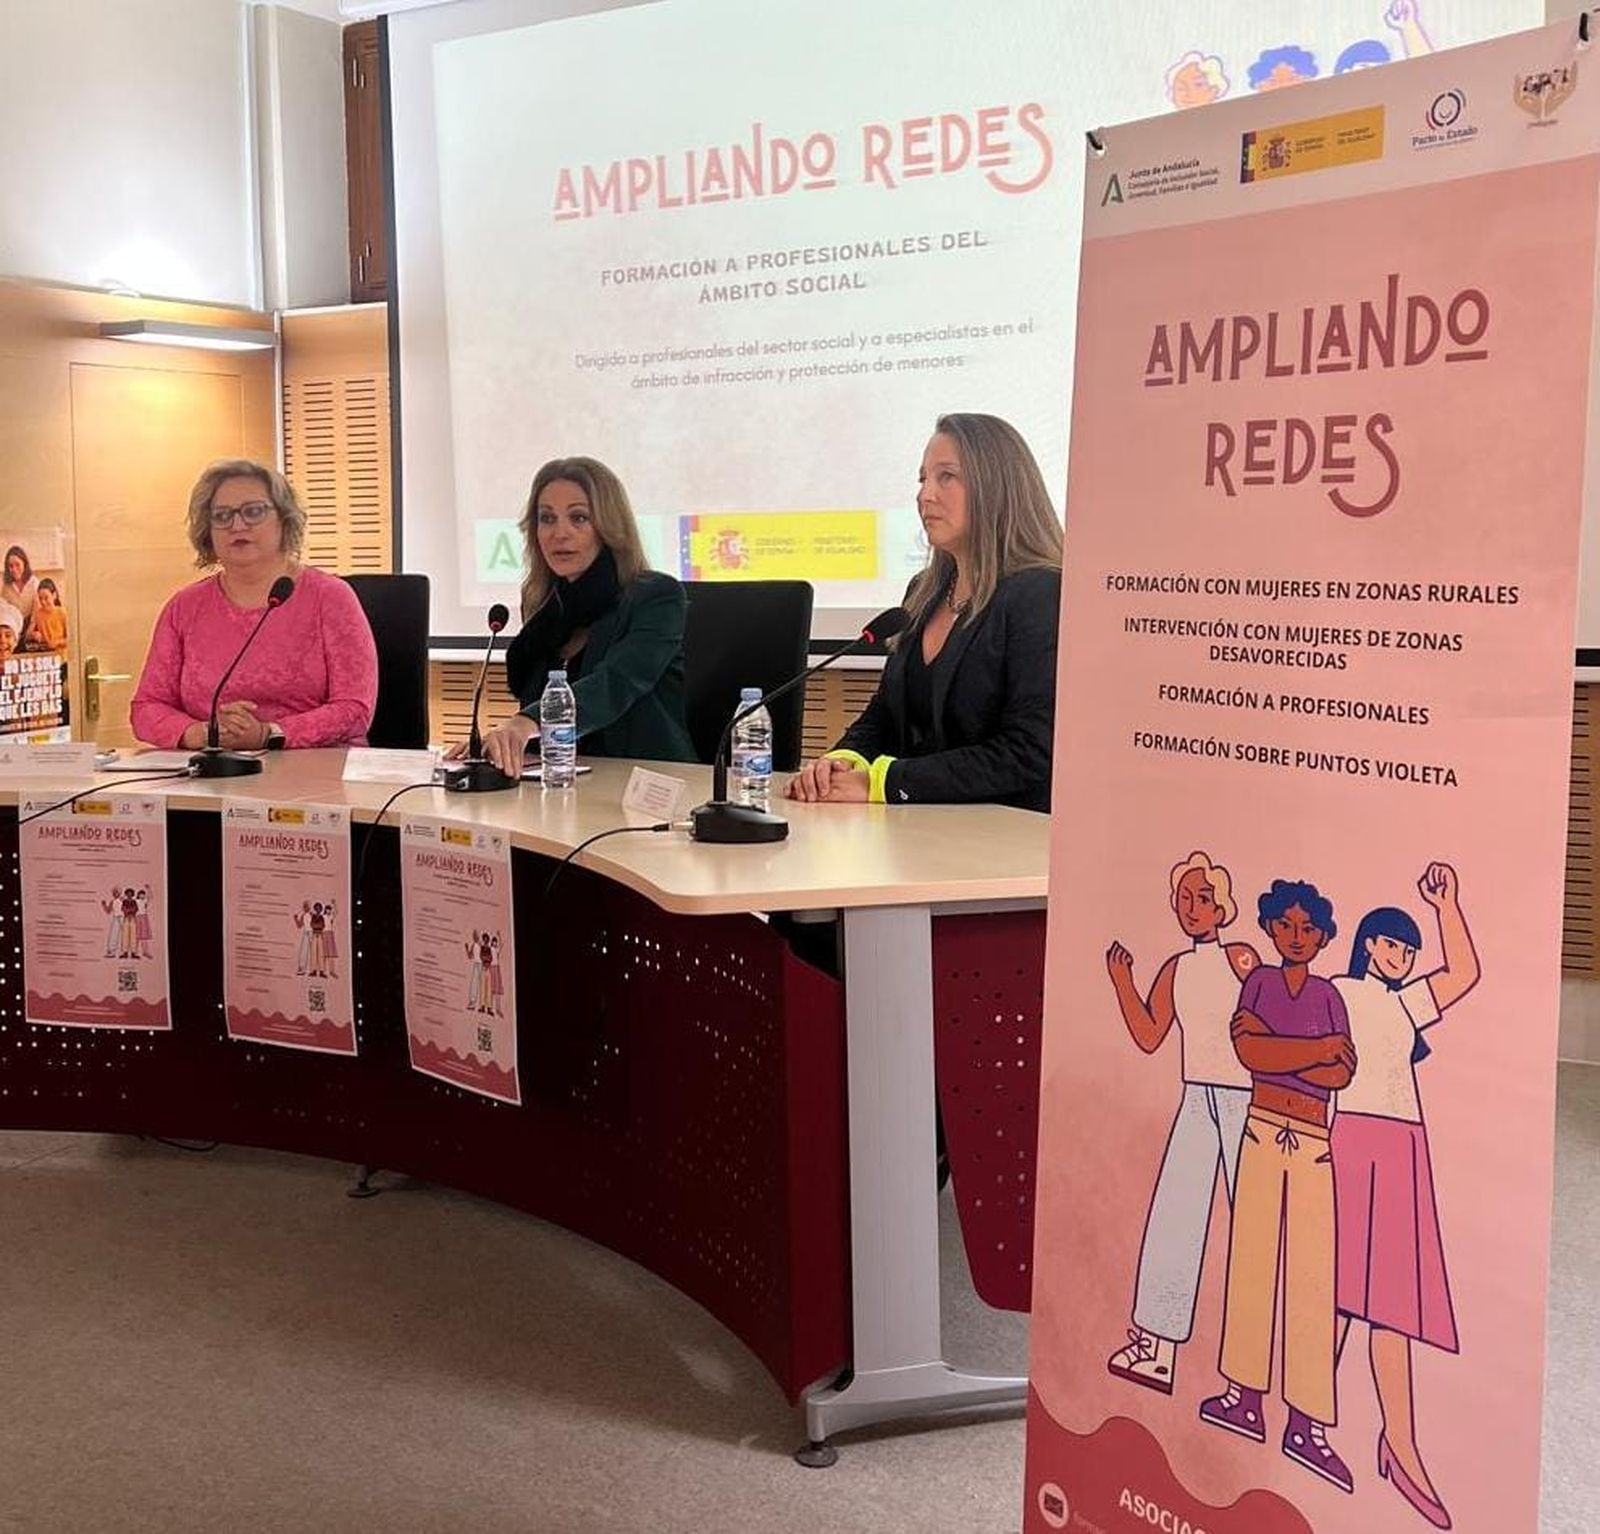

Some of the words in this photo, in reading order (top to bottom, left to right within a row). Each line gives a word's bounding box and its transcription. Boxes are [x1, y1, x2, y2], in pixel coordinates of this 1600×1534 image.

[554, 122, 837, 221] AMPLIANDO
[862, 102, 1053, 194] REDES
[601, 256, 717, 287] FORMACIÓN
[725, 257, 738, 273] A
[747, 236, 931, 271] PROFESIONALES
[940, 230, 989, 251] DEL
[698, 282, 778, 304] ÁMBITO
[785, 272, 867, 296] SOCIAL
[575, 351, 625, 372] Dirigido
[629, 354, 640, 365] a
[642, 343, 733, 368] profesionales
[736, 340, 759, 356] del
[763, 339, 809, 355] sector
[811, 331, 855, 350] social
[858, 335, 868, 351] y
[871, 334, 882, 346] a
[886, 324, 988, 348] especialistas
[992, 323, 1014, 338] en
[1018, 318, 1033, 334] el
[1144, 273, 1490, 388] AMPLIANDO
[631, 372, 678, 390] ámbito
[682, 373, 700, 387] de
[704, 367, 773, 386] infracción
[776, 369, 786, 384] y
[789, 359, 868, 382] protección
[872, 357, 893, 373] de
[897, 355, 964, 372] menores
[1204, 413, 1400, 518] REDES
[1106, 573, 1199, 594] FORMACIÓN
[1204, 578, 1241, 595] CON
[1245, 579, 1321, 600] MUJERES
[1326, 582, 1351, 599] EN
[1355, 583, 1422, 602] ZONAS
[1428, 584, 1519, 605] RURALES
[1124, 617, 1239, 640] INTERVENCIÓN
[1243, 623, 1280, 642] CON
[1285, 626, 1362, 648] MUJERES
[1367, 630, 1391, 647] DE
[1396, 631, 1463, 652] ZONAS
[1209, 645, 1347, 670] DESAVORECIDAS
[1158, 685, 1258, 710] FORMACIÓN
[1263, 695, 1275, 711] A
[1280, 696, 1429, 725] PROFESIONALES
[1134, 733, 1230, 759] FORMACIÓN
[1235, 744, 1290, 767] SOBRE
[1295, 751, 1370, 777] PUNTOS
[1375, 761, 1458, 787] VIOLETA
[39, 824, 102, 840] AMPLIANDO
[105, 827, 142, 847] REDES
[239, 833, 295, 852] AMPLIANDO
